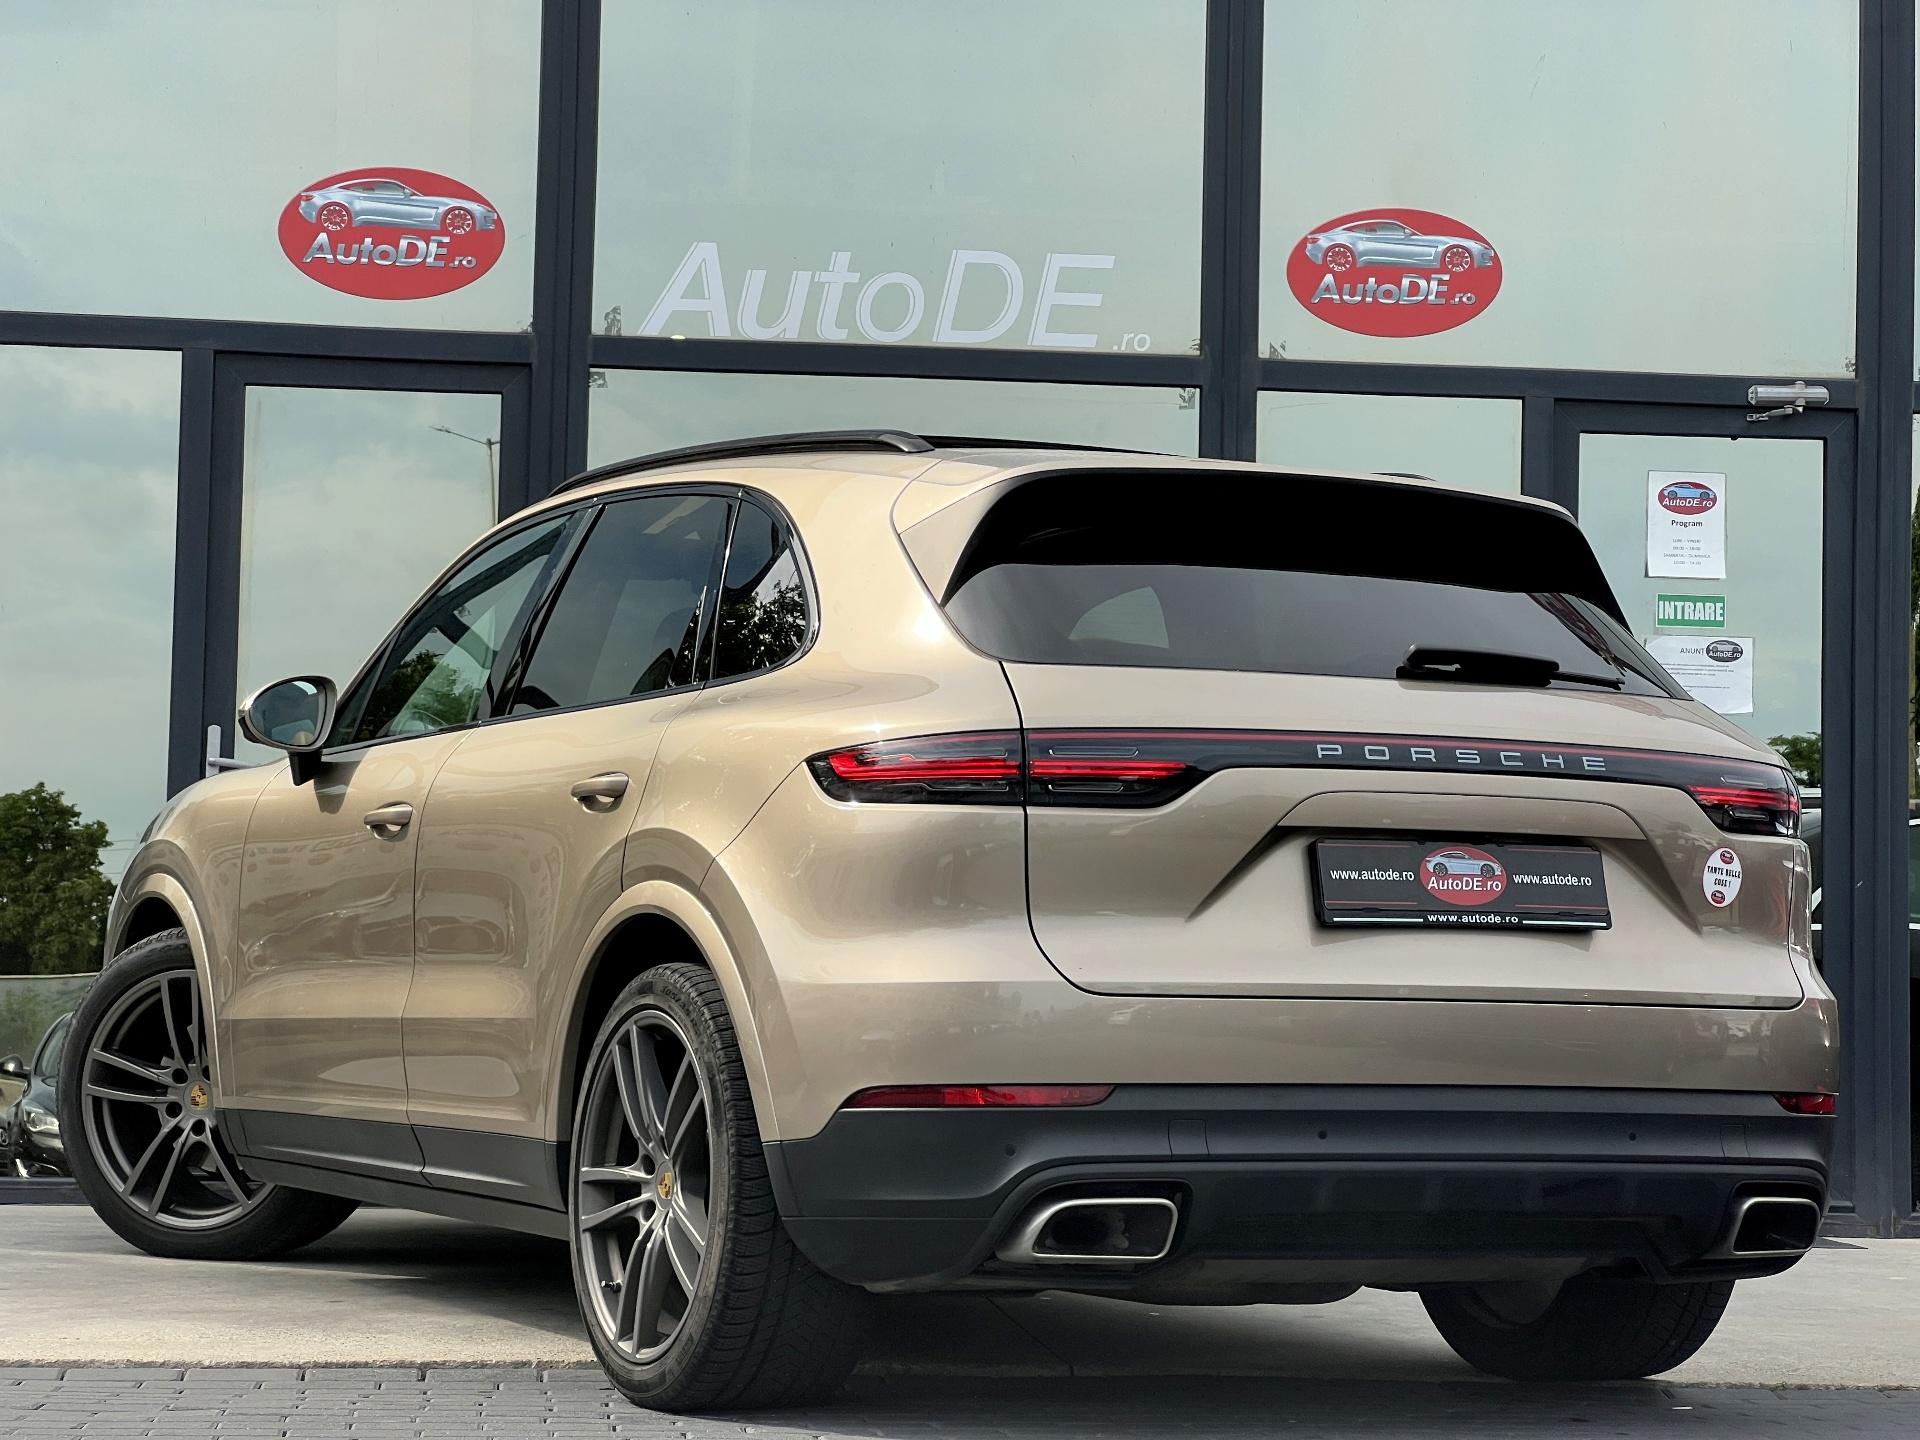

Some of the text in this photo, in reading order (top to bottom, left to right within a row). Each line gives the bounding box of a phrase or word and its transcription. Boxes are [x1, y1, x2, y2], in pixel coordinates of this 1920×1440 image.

[1662, 498, 1713, 507] AutoDE.ro
[1671, 519, 1703, 528] Program
[1658, 601, 1724, 620] INTRARE
[1708, 650, 1741, 658] AutoDE.ro
[1316, 744, 1606, 771] PORSCHE
[1330, 868, 1415, 882] www.autode.ro
[1513, 873, 1592, 887] www.autode.ro
[1427, 876, 1502, 892] AutoDE.ro
[1427, 914, 1519, 924] www.autode.ro
